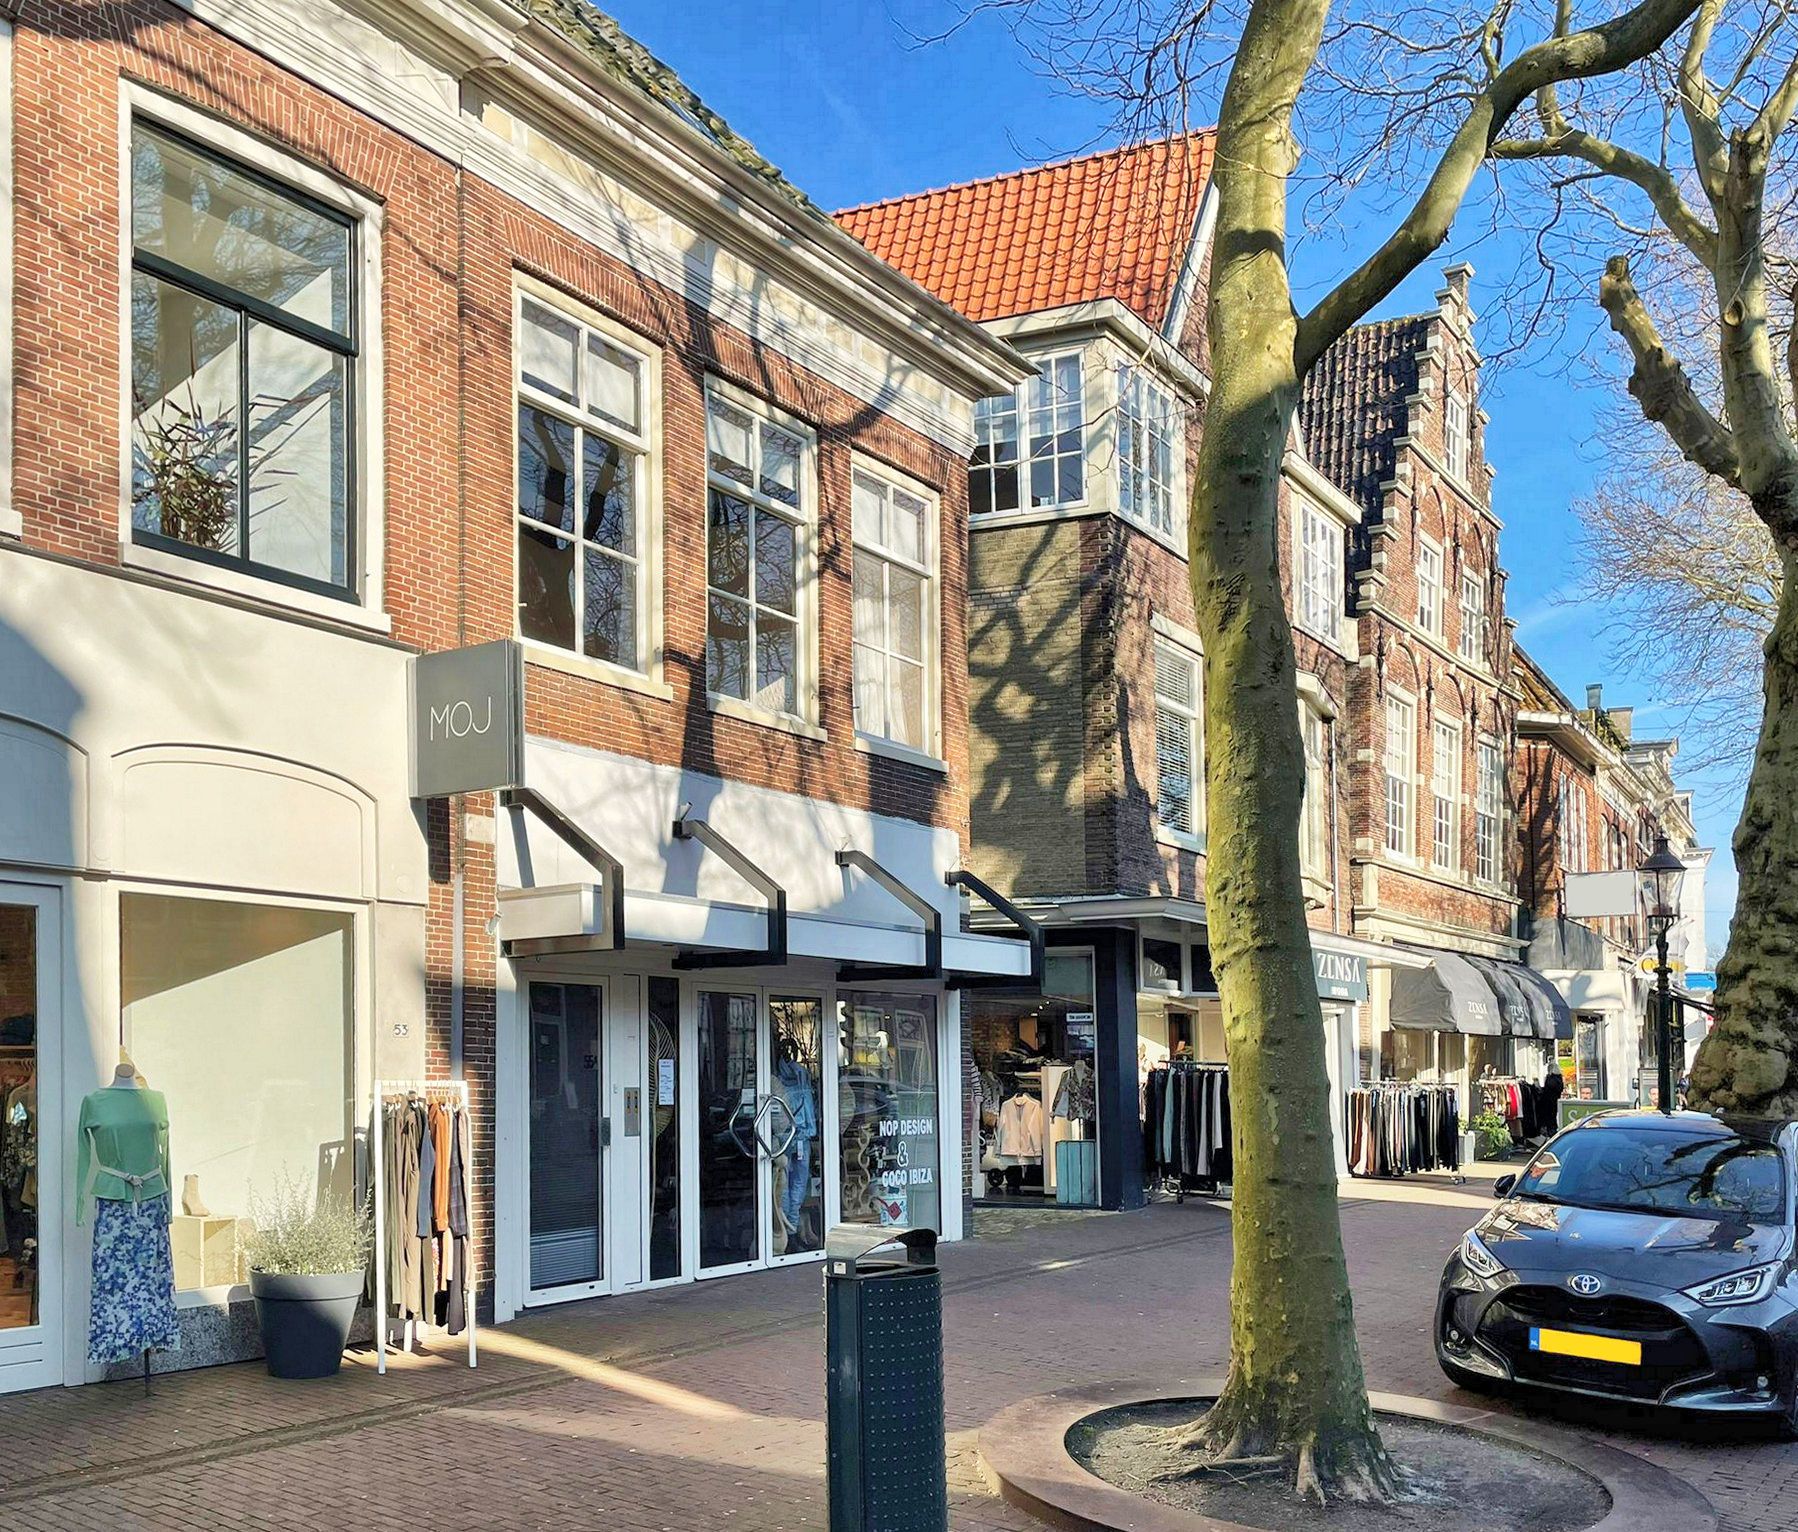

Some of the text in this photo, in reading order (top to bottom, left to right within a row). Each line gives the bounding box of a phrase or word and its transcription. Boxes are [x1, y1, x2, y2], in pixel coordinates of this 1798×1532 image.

[430, 696, 491, 742] MOJ
[393, 1023, 408, 1036] 53
[880, 1119, 933, 1136] NOP DESIGN
[897, 1141, 909, 1167] &
[909, 1167, 933, 1185] IBIZA
